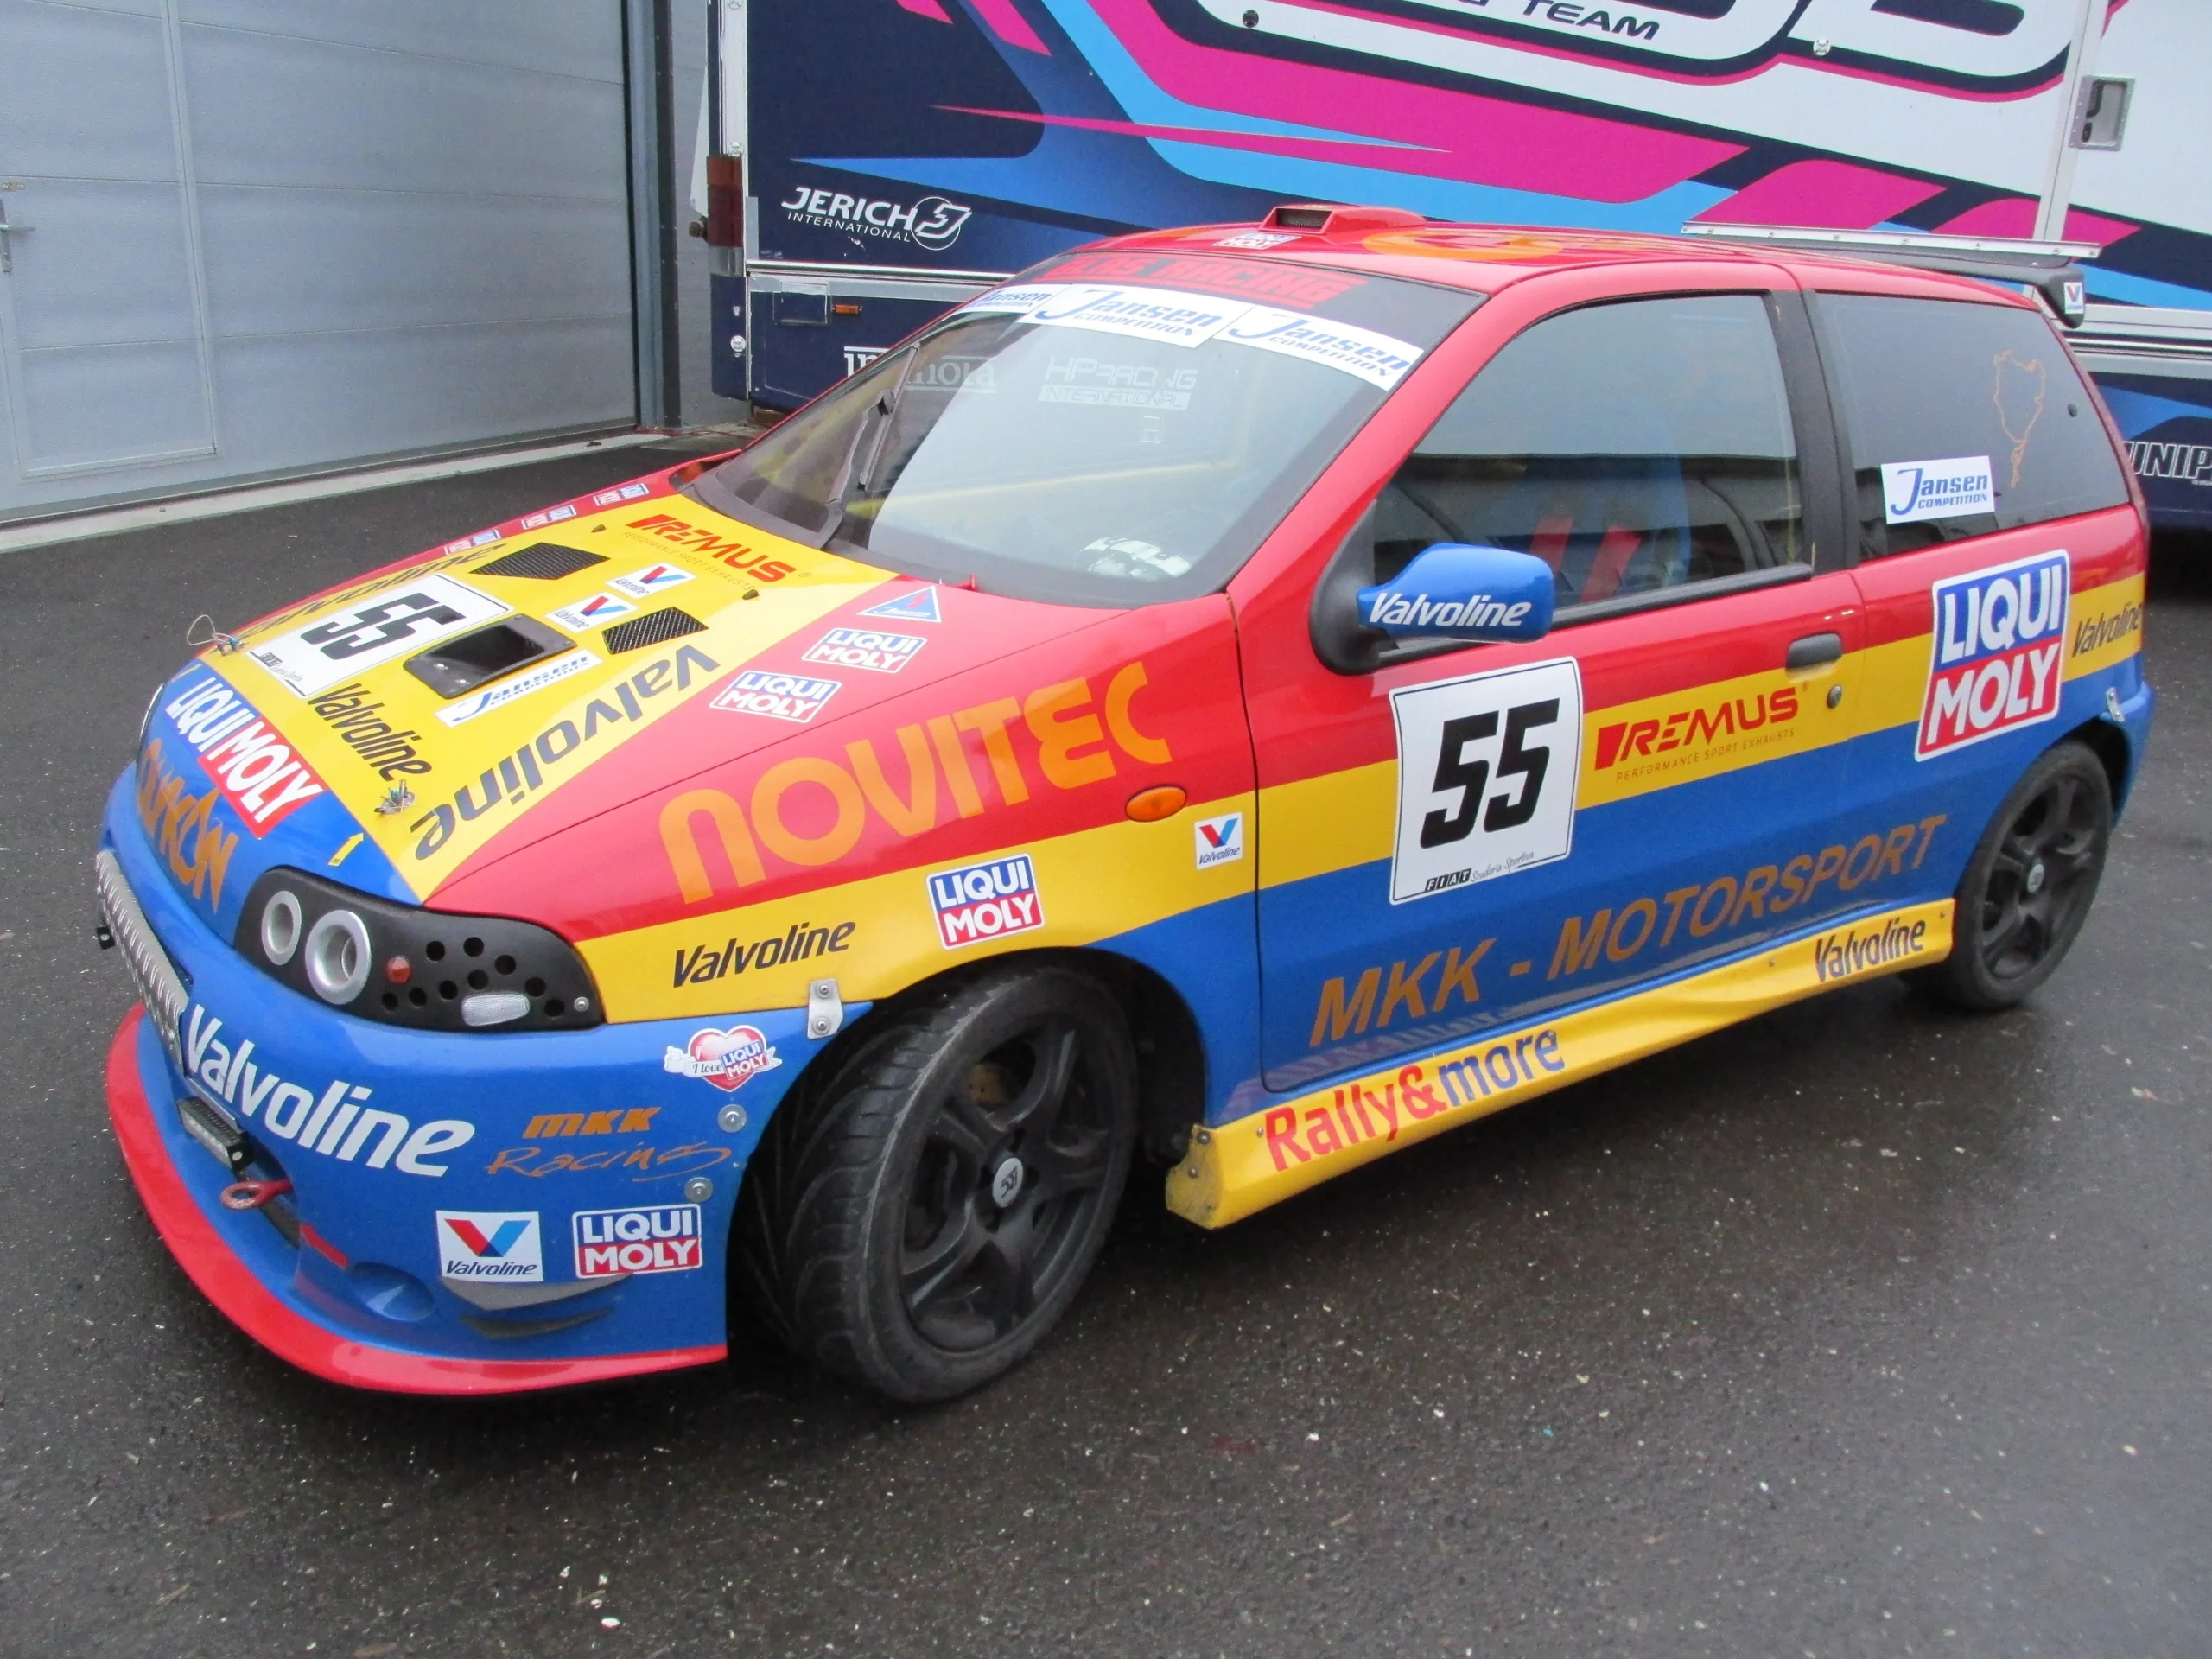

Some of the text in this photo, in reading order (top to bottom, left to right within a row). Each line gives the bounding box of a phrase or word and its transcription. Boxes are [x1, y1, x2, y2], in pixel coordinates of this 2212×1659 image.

[1522, 0, 1660, 41] TEAM
[781, 186, 918, 231] JERICH
[787, 211, 911, 243] INTERNATIONAL
[1034, 289, 1223, 327] Jansen
[1073, 313, 1198, 337] COMPETITION
[1228, 313, 1411, 371] Jansen
[1268, 335, 1392, 378] COMPETITION
[1890, 467, 1988, 516] Jansen
[1917, 493, 1988, 509] COMPETITION
[626, 513, 797, 582] REMUS
[300, 592, 467, 660] 55
[1369, 592, 1532, 627] Valvoline
[1941, 564, 2062, 664] LIQUI
[810, 645, 907, 670] MOLY
[832, 630, 919, 654] LIQUI
[451, 655, 589, 722] Jansen
[719, 690, 819, 718] MOLY
[735, 672, 830, 700] LIQUI
[1926, 642, 2061, 746] MOLY
[166, 677, 324, 823] LIQUI MOLY
[307, 682, 432, 781] Valvoline
[410, 643, 721, 861] Valvoline
[1595, 686, 1799, 771] REMUS
[1420, 696, 1561, 850] 55
[1616, 728, 1796, 782] PERFORMANCE SPORT EXHAUSTS
[658, 661, 1173, 905] NOVITEC
[1198, 846, 1241, 865] Valvoline
[933, 860, 1032, 912] LIQUI
[1426, 868, 1471, 892] FIAT
[942, 893, 1038, 944] MOLY
[1309, 938, 1497, 1047] MKK
[1546, 814, 1948, 981] MOTORSPORT
[673, 921, 856, 988] Valvoline
[1815, 916, 1927, 983] Valvoline
[701, 1062, 722, 1073] love
[722, 1042, 762, 1067] LIQUI
[727, 1054, 765, 1078] MOLY
[188, 1004, 476, 1178] Valvoline
[1264, 1029, 1567, 1172] Rally&more
[486, 1141, 732, 1182] Racing
[582, 1209, 693, 1244] LIQUI
[446, 1260, 538, 1276] Valvoline
[585, 1238, 697, 1274] MOLY
